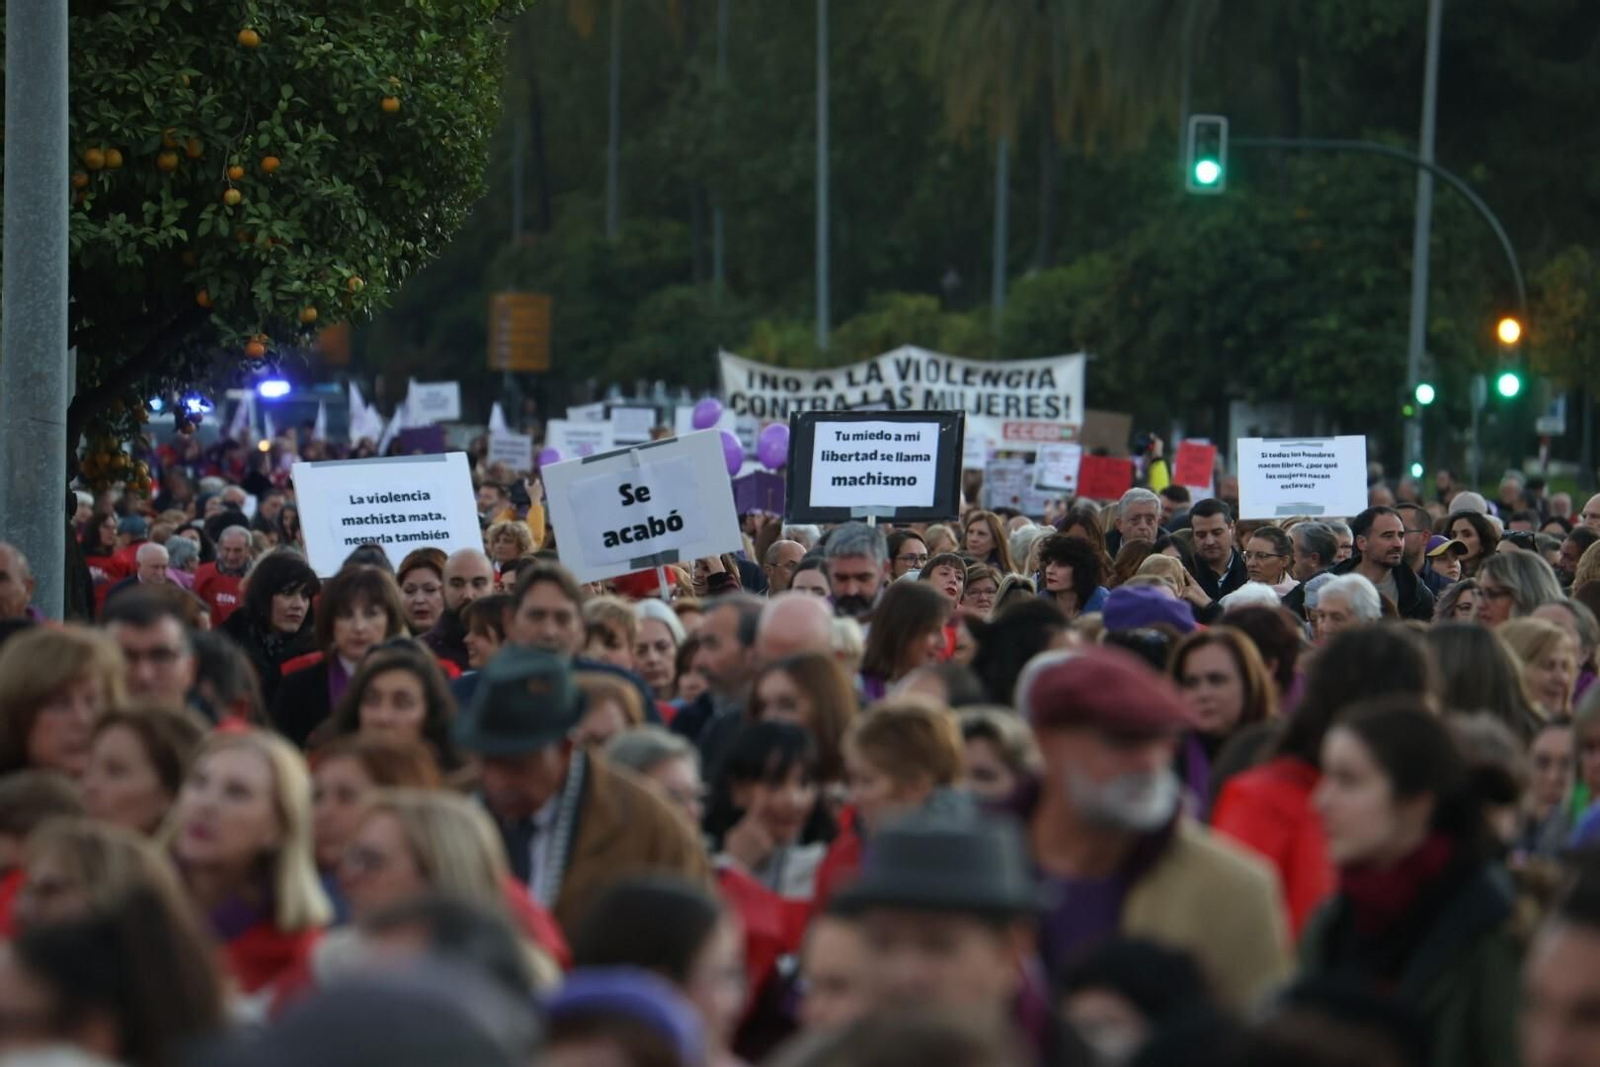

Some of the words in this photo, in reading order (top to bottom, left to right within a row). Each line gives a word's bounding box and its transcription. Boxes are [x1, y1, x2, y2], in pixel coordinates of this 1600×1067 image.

[814, 376, 834, 390] A
[846, 360, 884, 387] LA
[894, 356, 1056, 389] VIOLENCIA
[729, 391, 850, 419] CONTRA
[923, 388, 1072, 419] MUJERES!
[835, 431, 850, 441] Tu
[852, 430, 892, 441] miedo
[894, 433, 902, 441] a
[904, 431, 921, 441] mi
[821, 450, 878, 462] libertad
[880, 453, 894, 462] se
[895, 452, 931, 462] llama
[1323, 462, 1338, 470] qué
[831, 472, 917, 486] machismo
[1277, 472, 1307, 480] mujeres
[349, 495, 364, 505] La
[366, 490, 431, 504] violencia
[618, 483, 651, 506] Se
[341, 513, 406, 526] machista
[602, 509, 684, 548] acabó
[344, 534, 393, 545] negarla
[395, 530, 450, 543] también
